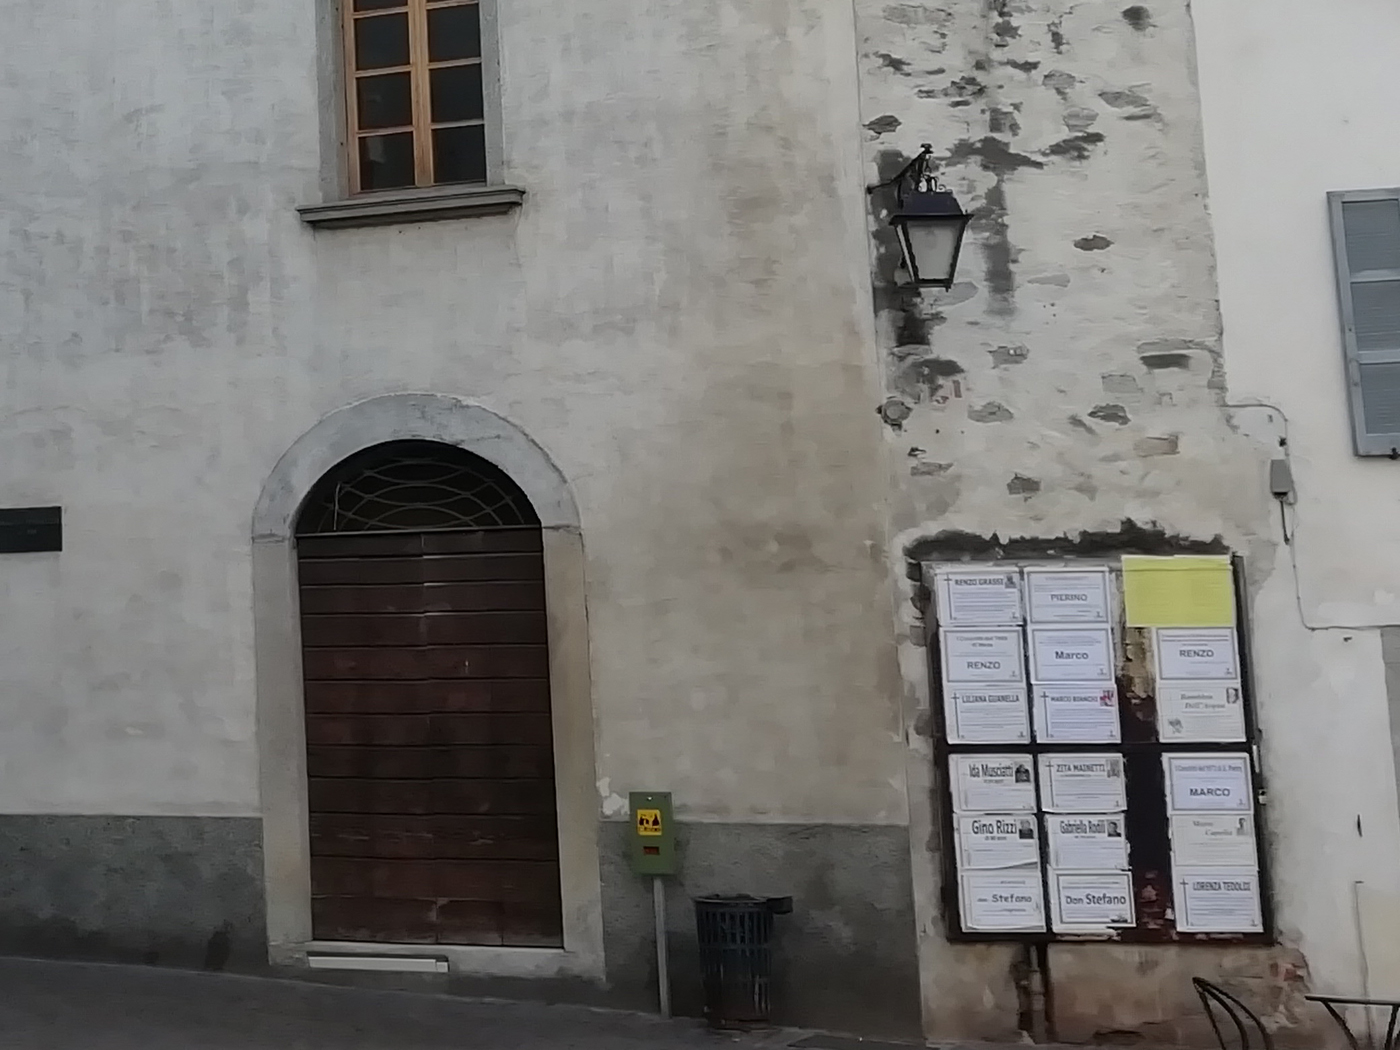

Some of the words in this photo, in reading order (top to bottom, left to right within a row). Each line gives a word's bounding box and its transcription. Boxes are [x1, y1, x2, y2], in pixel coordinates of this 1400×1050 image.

[1055, 650, 1089, 660] Marco
[1179, 649, 1214, 658] RENZO
[966, 661, 1001, 670] RENZO
[969, 763, 980, 778] Ida
[1189, 788, 1231, 797] MARCO
[971, 819, 994, 835] Gino
[996, 819, 1018, 834] Rizzi
[991, 893, 1033, 903] Stefano
[1085, 893, 1127, 905] Stefano
